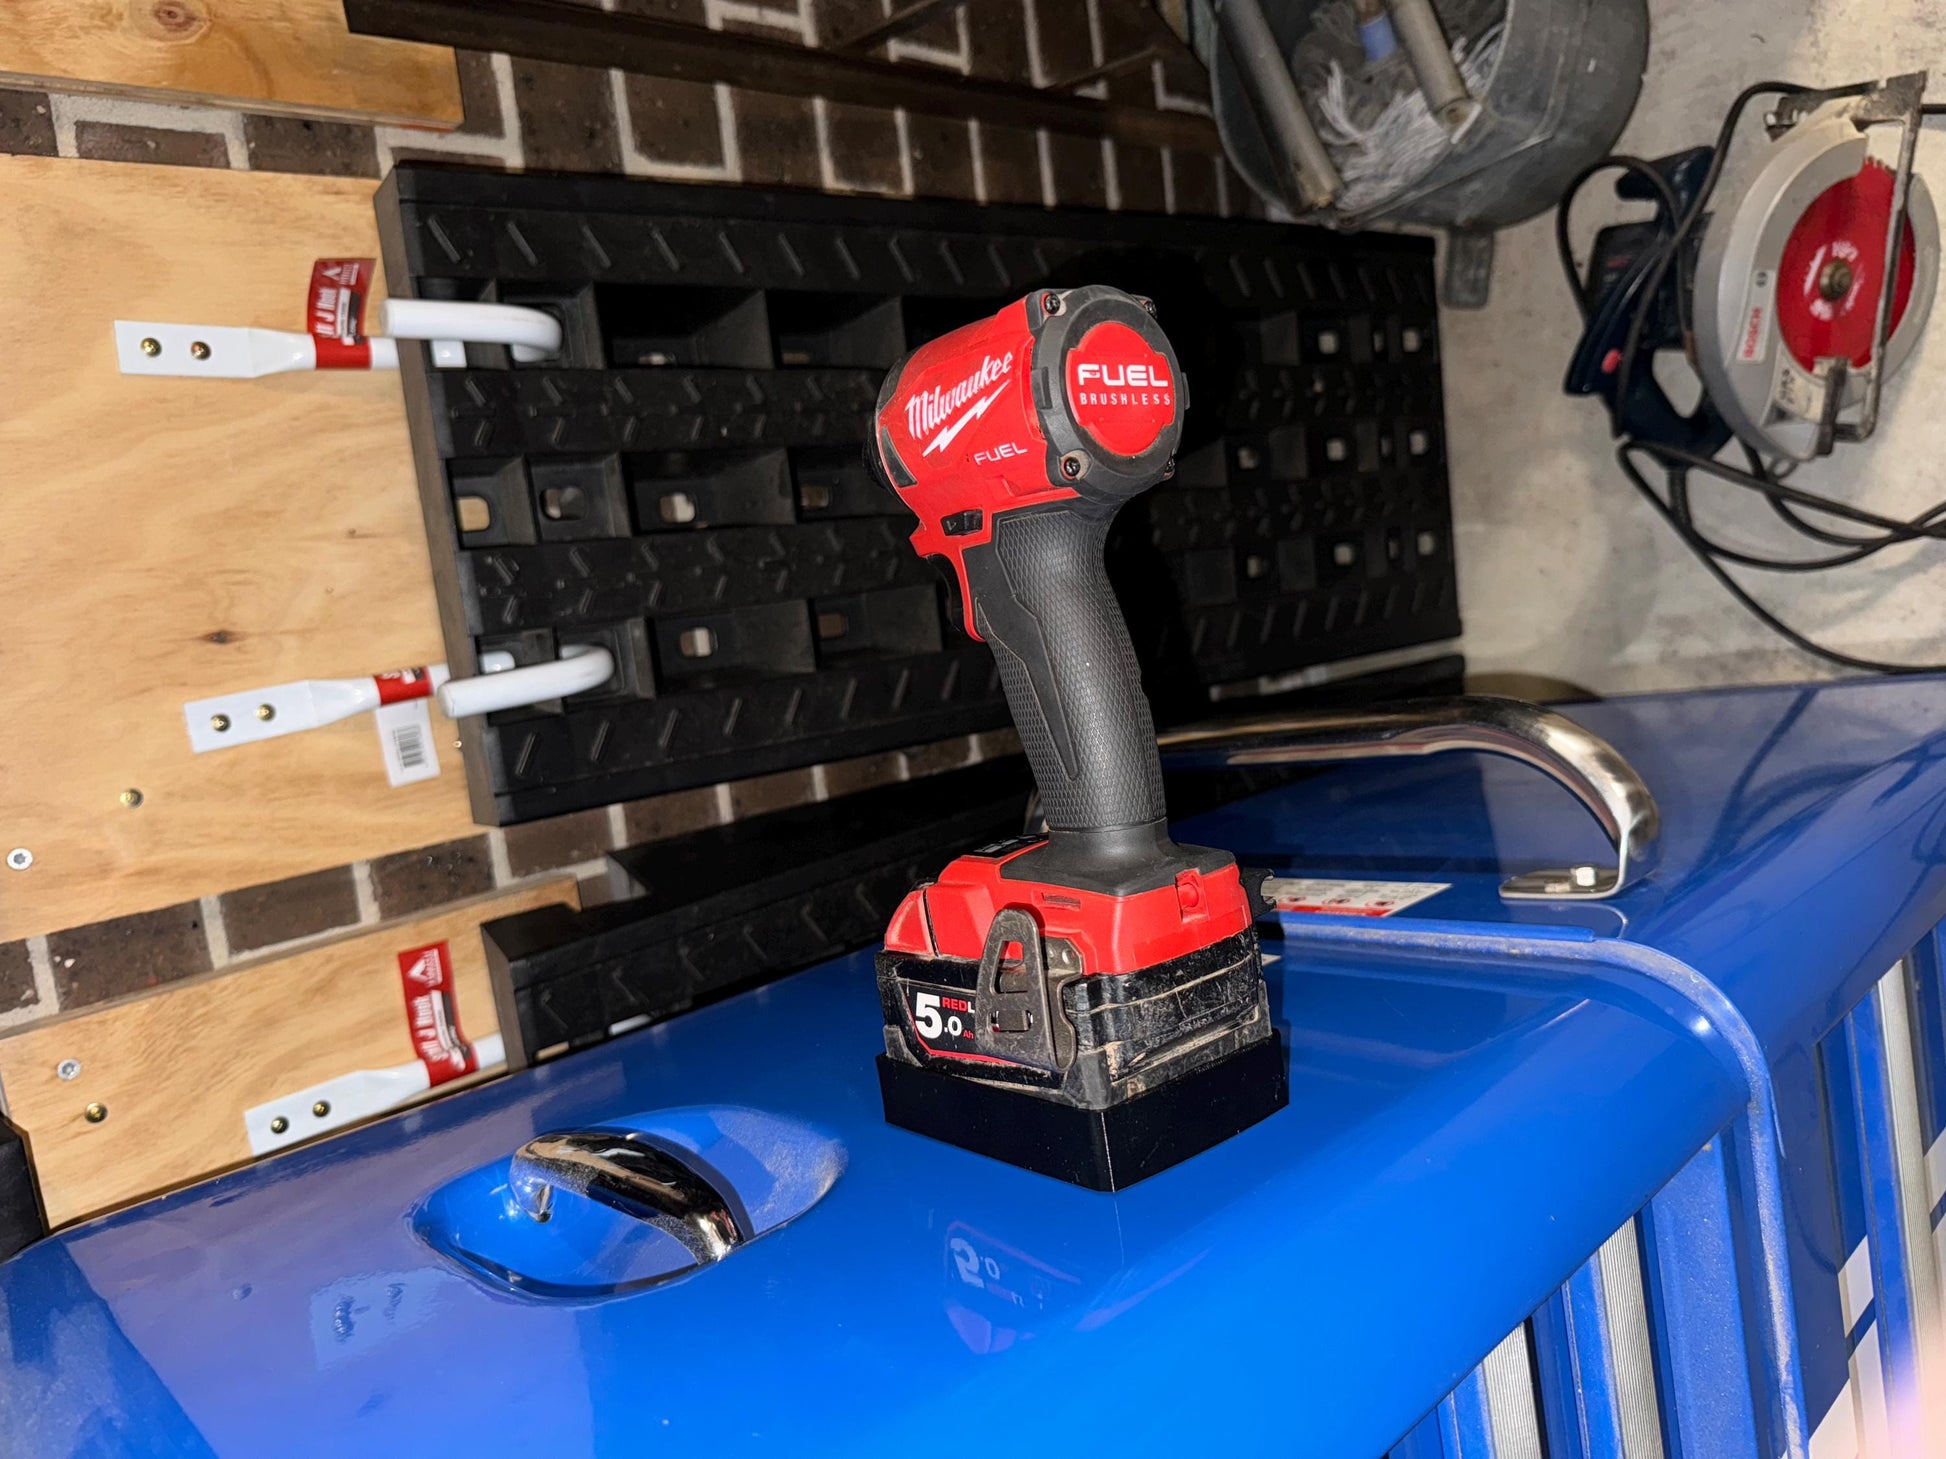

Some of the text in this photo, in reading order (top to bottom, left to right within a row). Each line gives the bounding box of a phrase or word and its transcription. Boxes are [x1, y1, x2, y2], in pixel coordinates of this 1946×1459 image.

[1077, 363, 1169, 387] FUEL
[904, 351, 1013, 440] Milwaukee
[1079, 392, 1171, 405] BRUSHLESS
[974, 442, 1028, 465] FUEL
[915, 992, 962, 1039] 5.0
